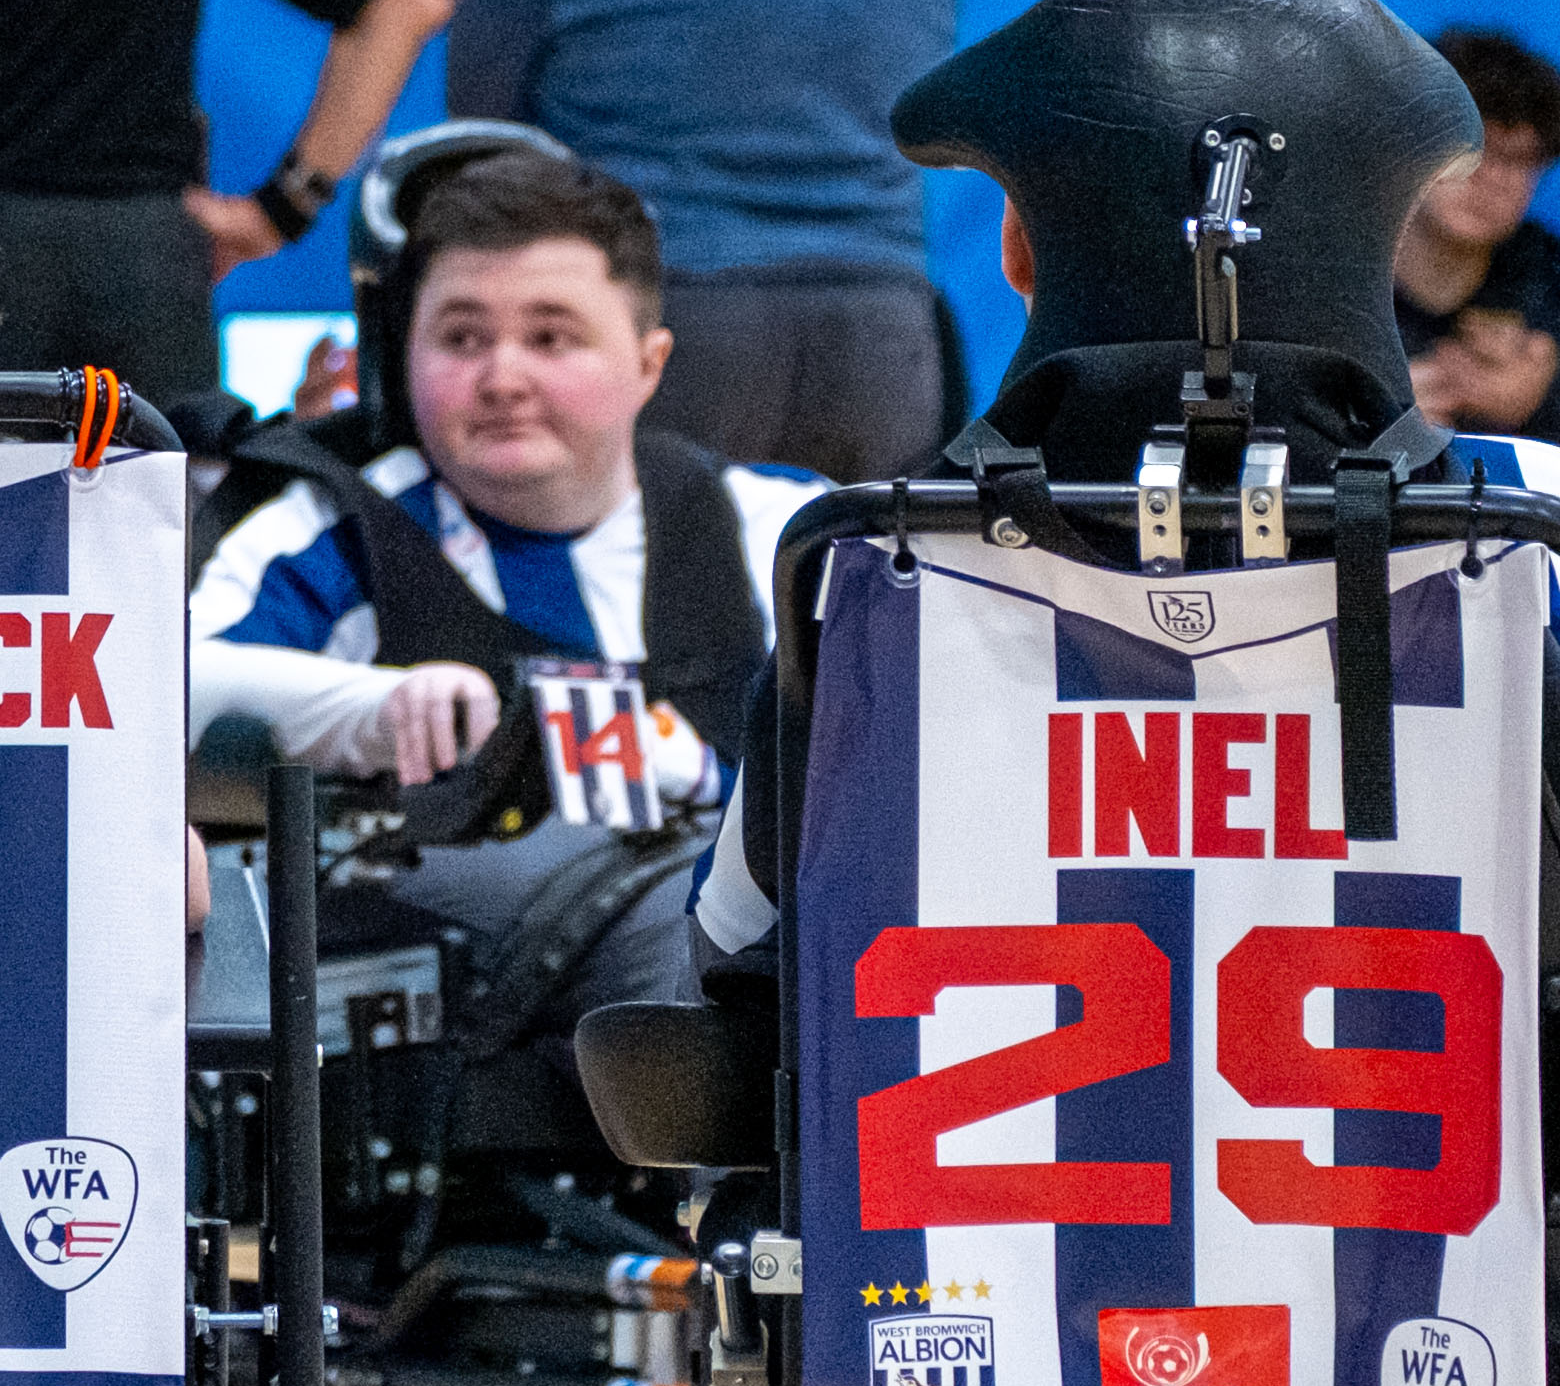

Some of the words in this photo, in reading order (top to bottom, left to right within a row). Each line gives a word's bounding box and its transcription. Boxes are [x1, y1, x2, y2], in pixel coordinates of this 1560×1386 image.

[1159, 600, 1204, 622] 125
[547, 711, 644, 785] 14
[1047, 711, 1349, 860] INEL
[854, 923, 1504, 1237] 29
[44, 1146, 87, 1166] The
[22, 1168, 110, 1201] WFA
[877, 1326, 911, 1338] WEST
[915, 1323, 986, 1337] BROMWICH
[1420, 1325, 1451, 1350] The
[878, 1336, 987, 1364] ALBION
